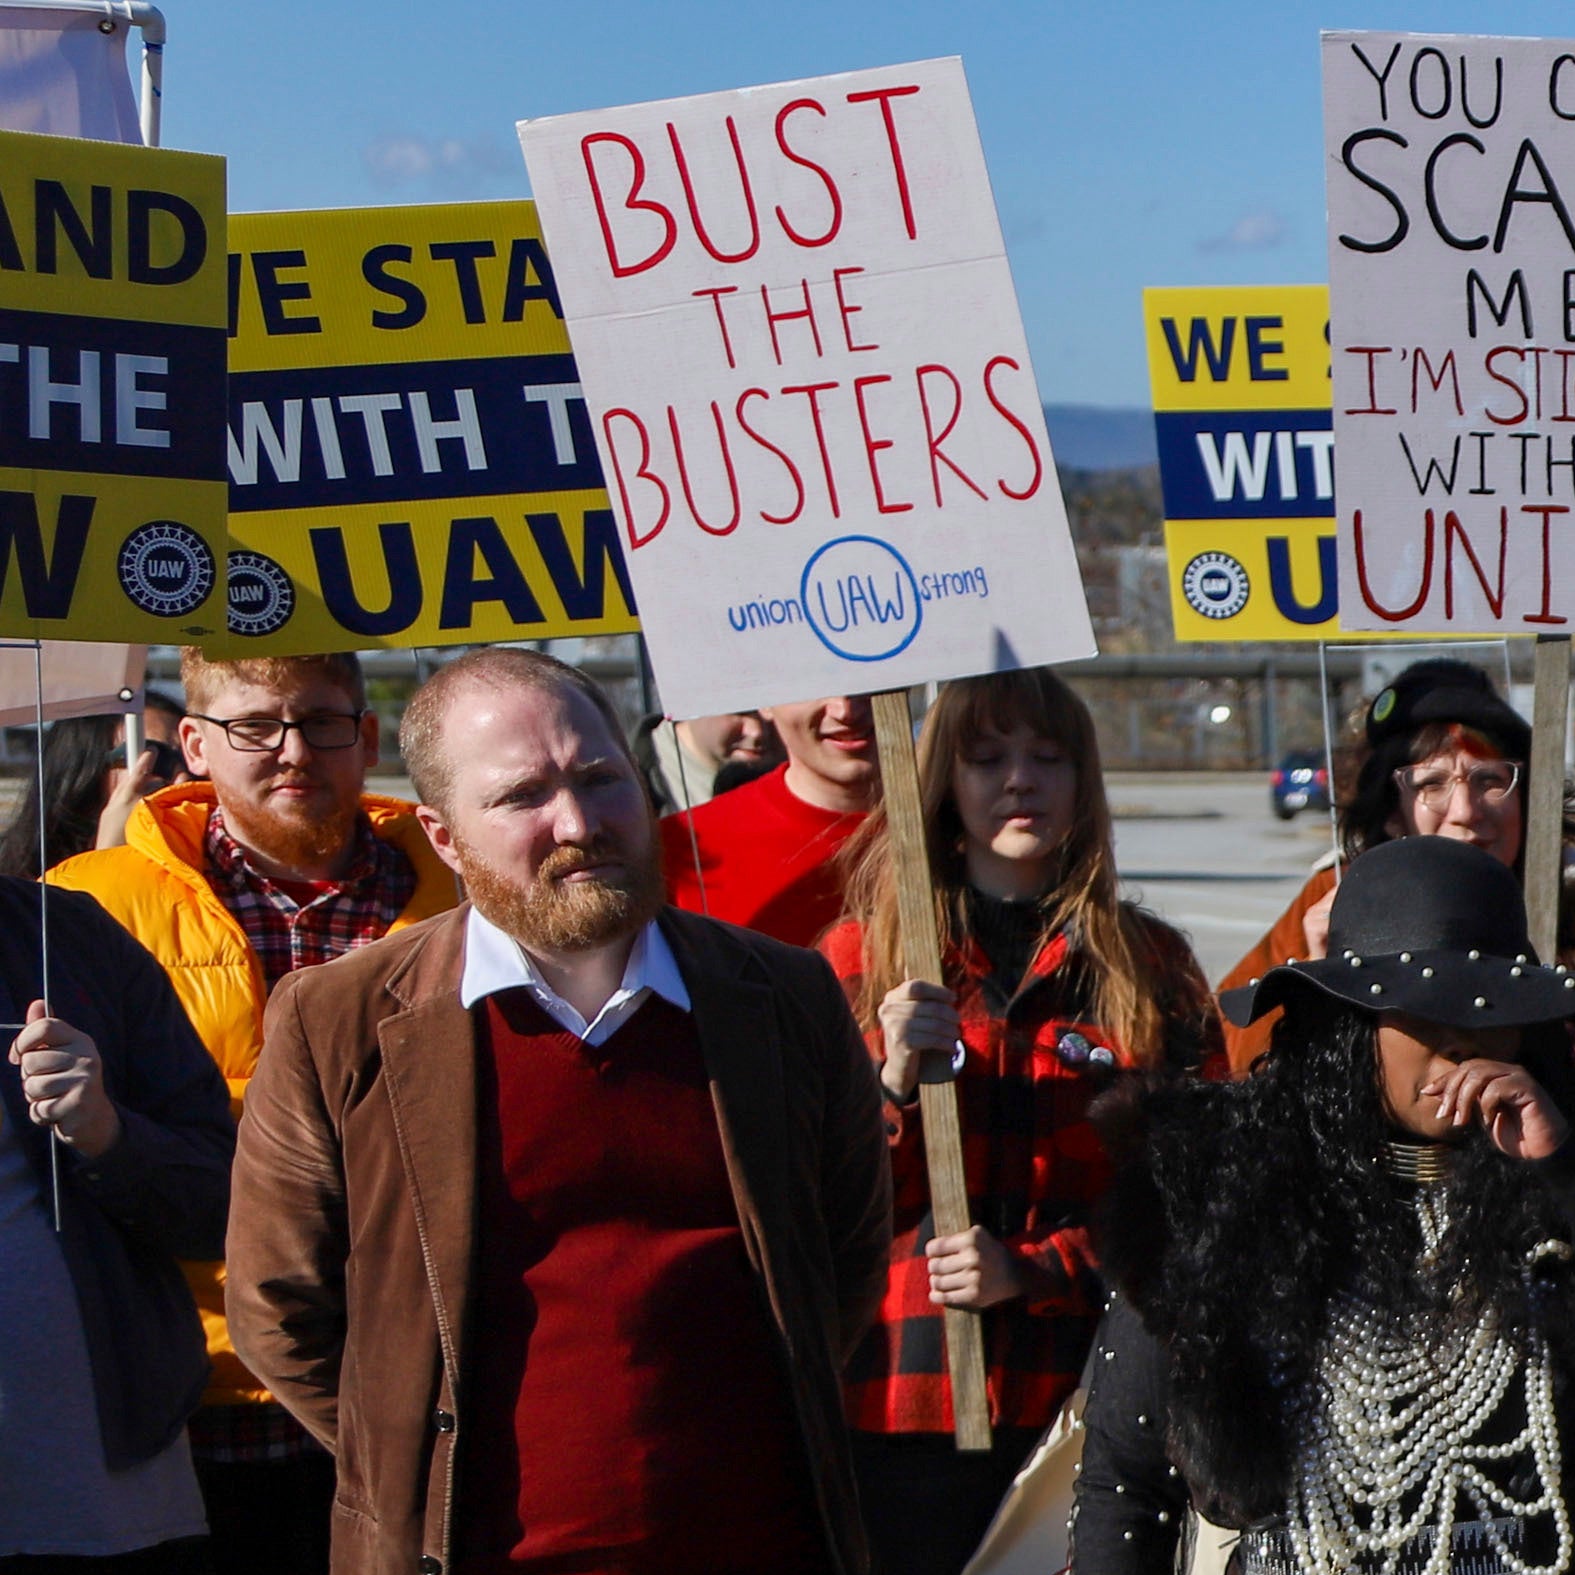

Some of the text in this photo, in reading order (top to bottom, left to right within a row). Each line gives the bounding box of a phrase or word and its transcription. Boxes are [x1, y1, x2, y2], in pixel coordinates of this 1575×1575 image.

[1351, 43, 1503, 129] YOU
[581, 85, 920, 278] BUST
[227, 237, 564, 338] E STA
[692, 266, 880, 369] THE
[1161, 315, 1290, 383] WE
[1344, 346, 1464, 416] I'M
[227, 388, 488, 486] WITH
[603, 354, 1043, 551] BUSTERS
[1196, 430, 1334, 502] WIT
[148, 559, 185, 579] UAW
[229, 584, 264, 603] UAW
[308, 509, 639, 638] UAW
[727, 565, 989, 633] union UAW strong
